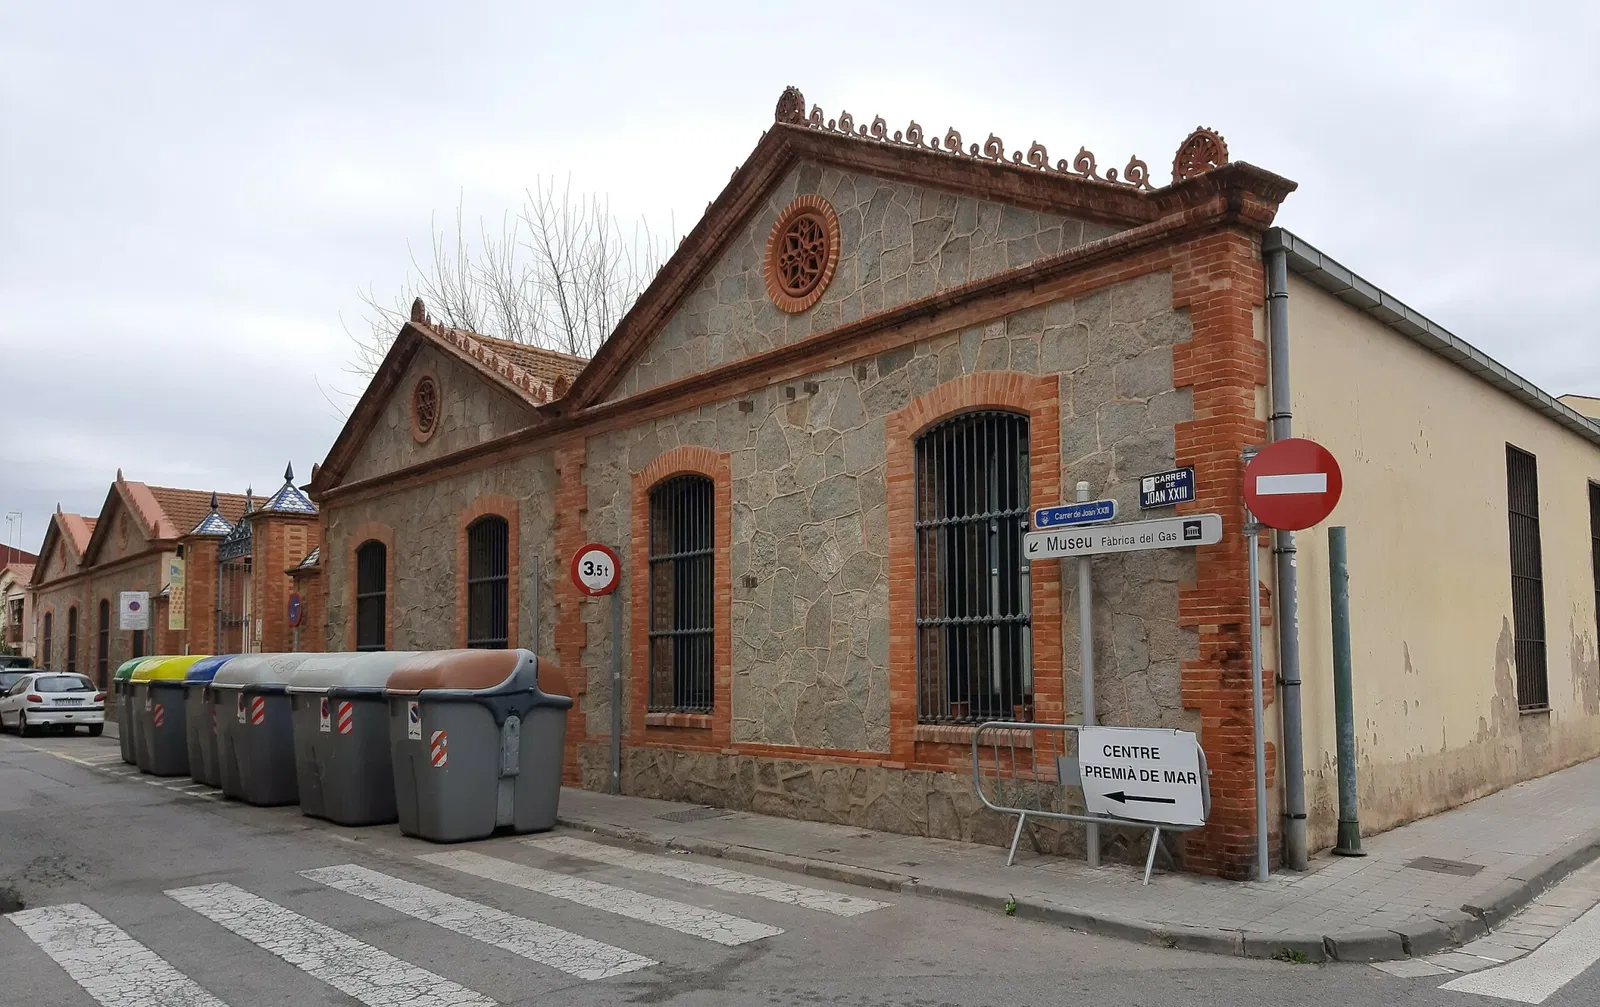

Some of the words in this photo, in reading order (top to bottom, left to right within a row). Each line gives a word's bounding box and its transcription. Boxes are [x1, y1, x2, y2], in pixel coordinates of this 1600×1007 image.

[1154, 471, 1187, 483] CARRER
[1165, 481, 1176, 489] DE
[1145, 489, 1166, 505] JOAN
[1168, 486, 1188, 501] XXIII
[1054, 511, 1073, 521] Carrer
[1073, 510, 1081, 518] de
[1081, 508, 1096, 517] Joan
[1047, 536, 1093, 552] Museu
[1101, 535, 1136, 547] Fàbrica
[1139, 533, 1154, 544] del
[1158, 531, 1178, 542] Gas
[1103, 745, 1160, 759] CENTRE
[1085, 765, 1137, 781] PREMIÀ
[1139, 769, 1161, 783] DE
[1163, 770, 1198, 785] MAR
